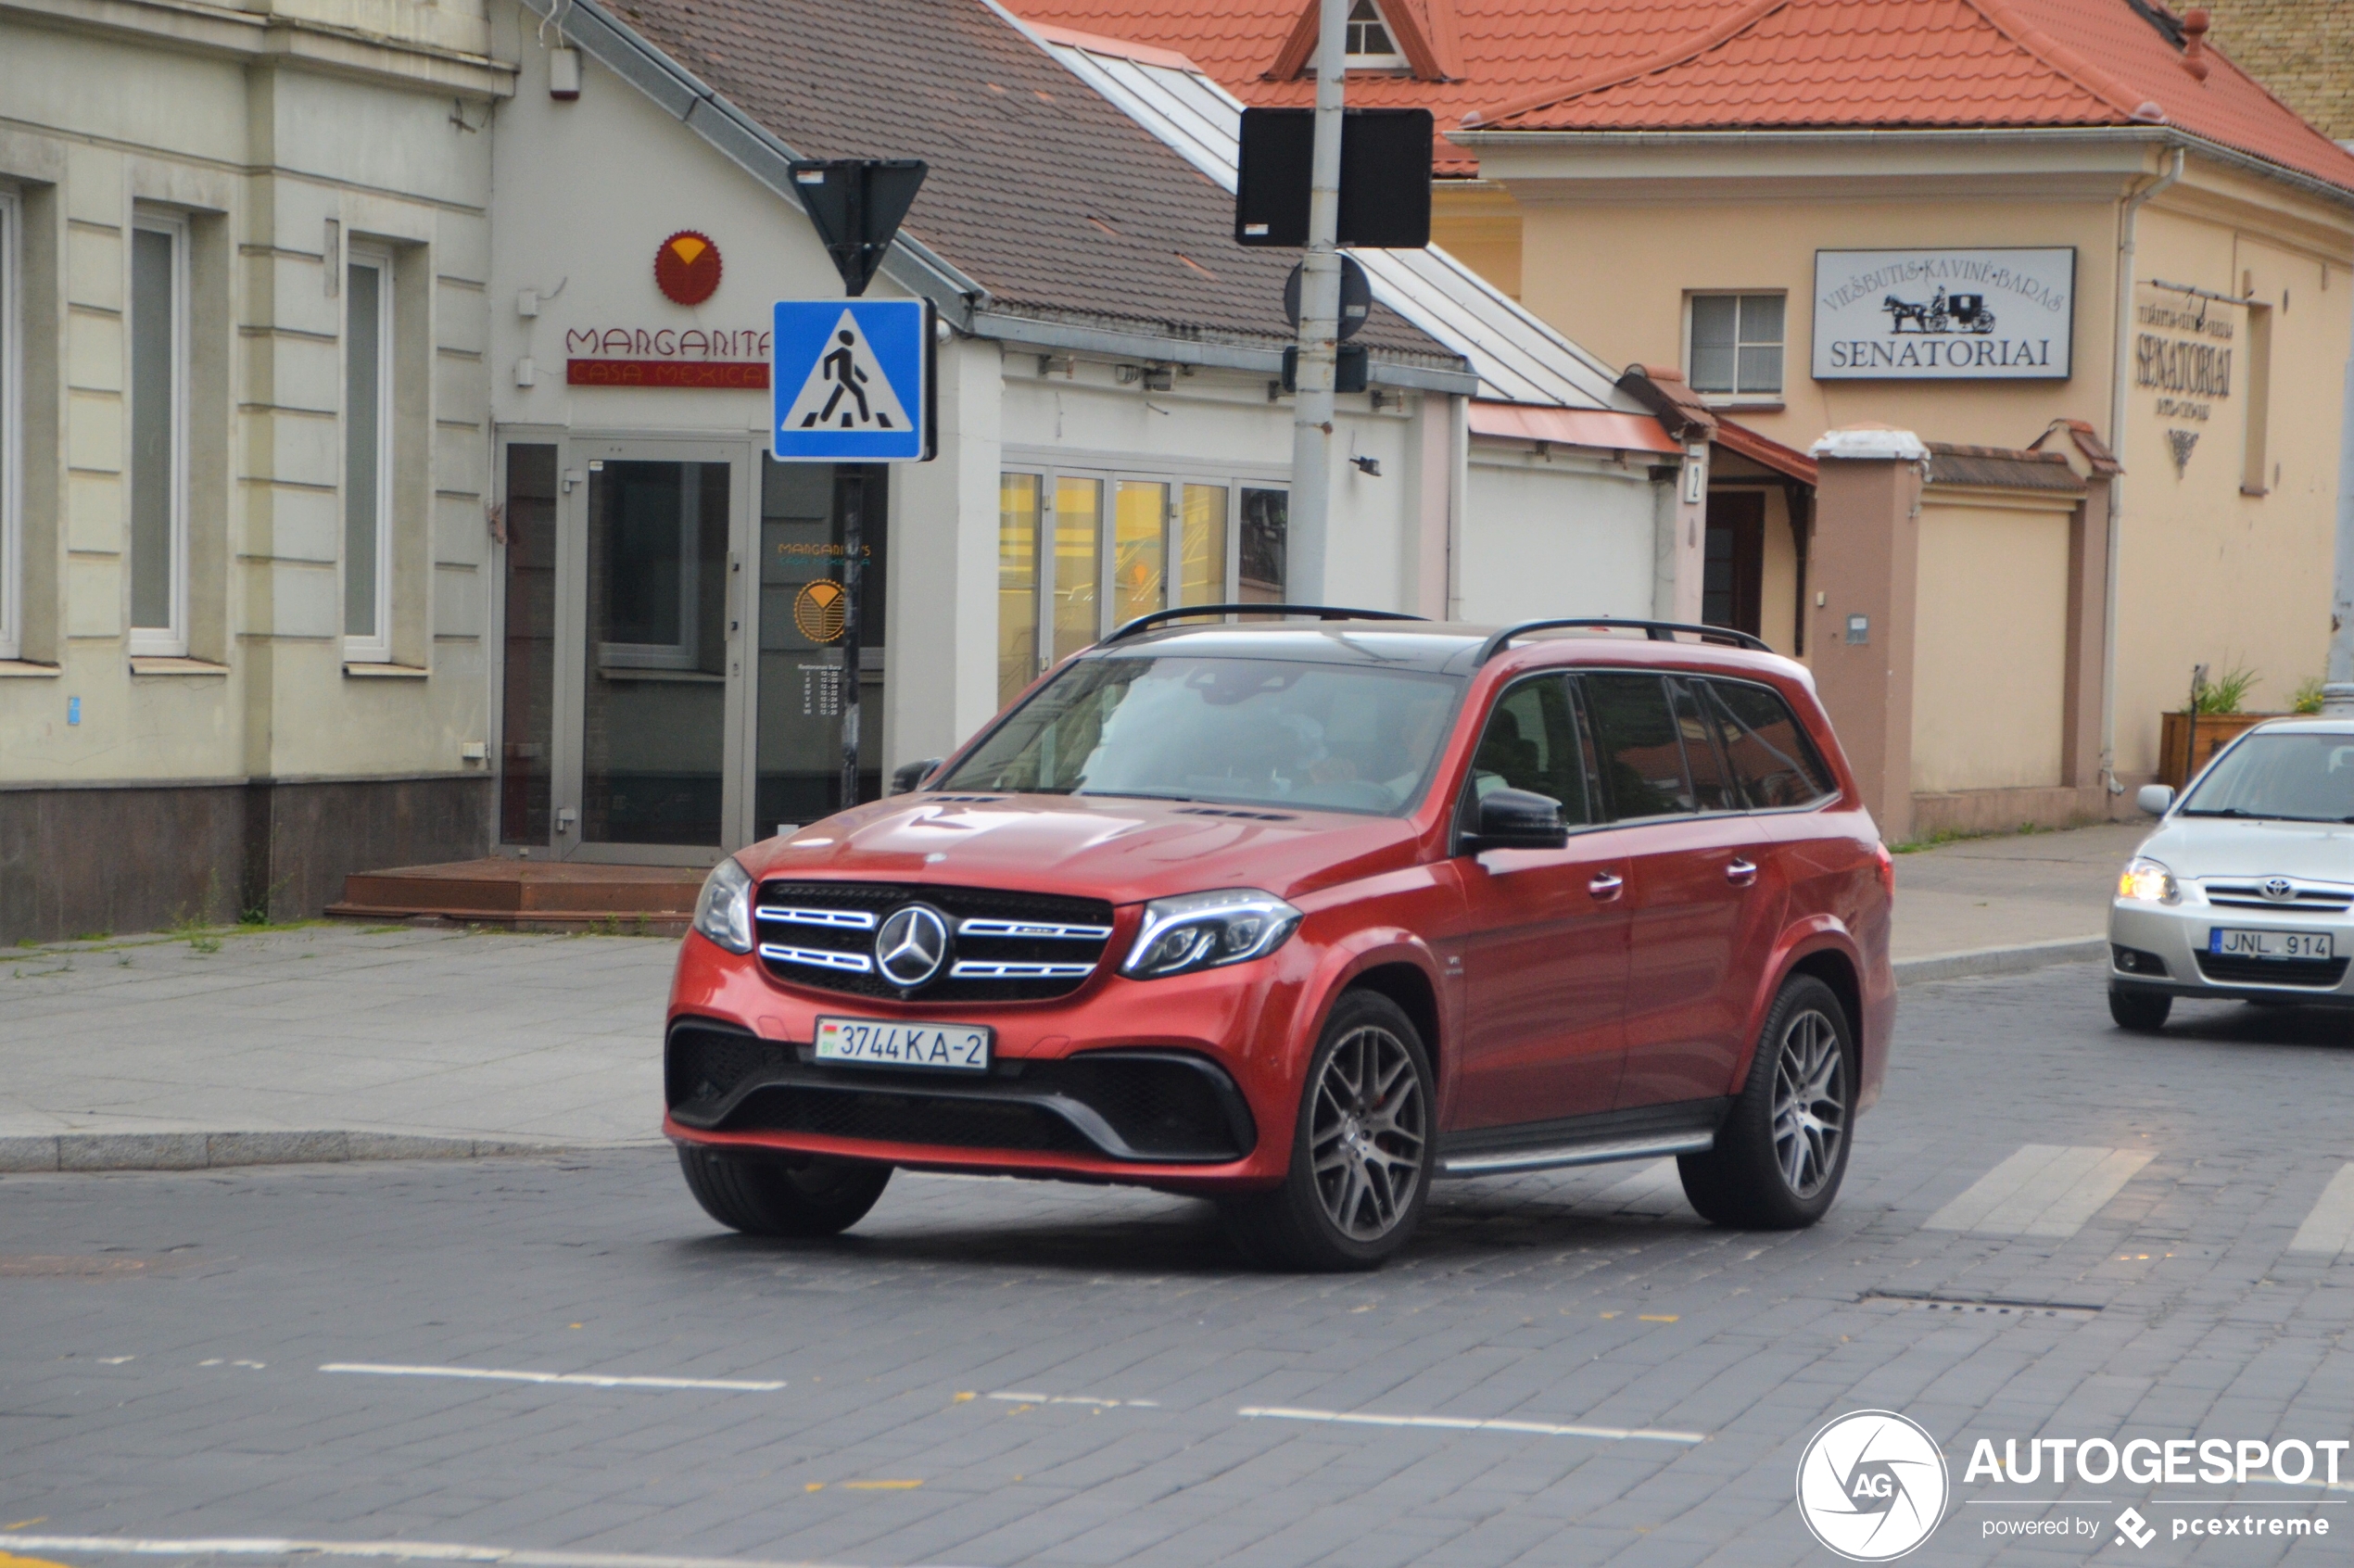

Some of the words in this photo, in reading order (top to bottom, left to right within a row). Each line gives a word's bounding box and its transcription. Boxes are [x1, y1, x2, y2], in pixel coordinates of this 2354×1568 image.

[1830, 339, 2051, 368] SENATORIAI
[2225, 933, 2271, 953] JNL
[2286, 935, 2326, 955] 914
